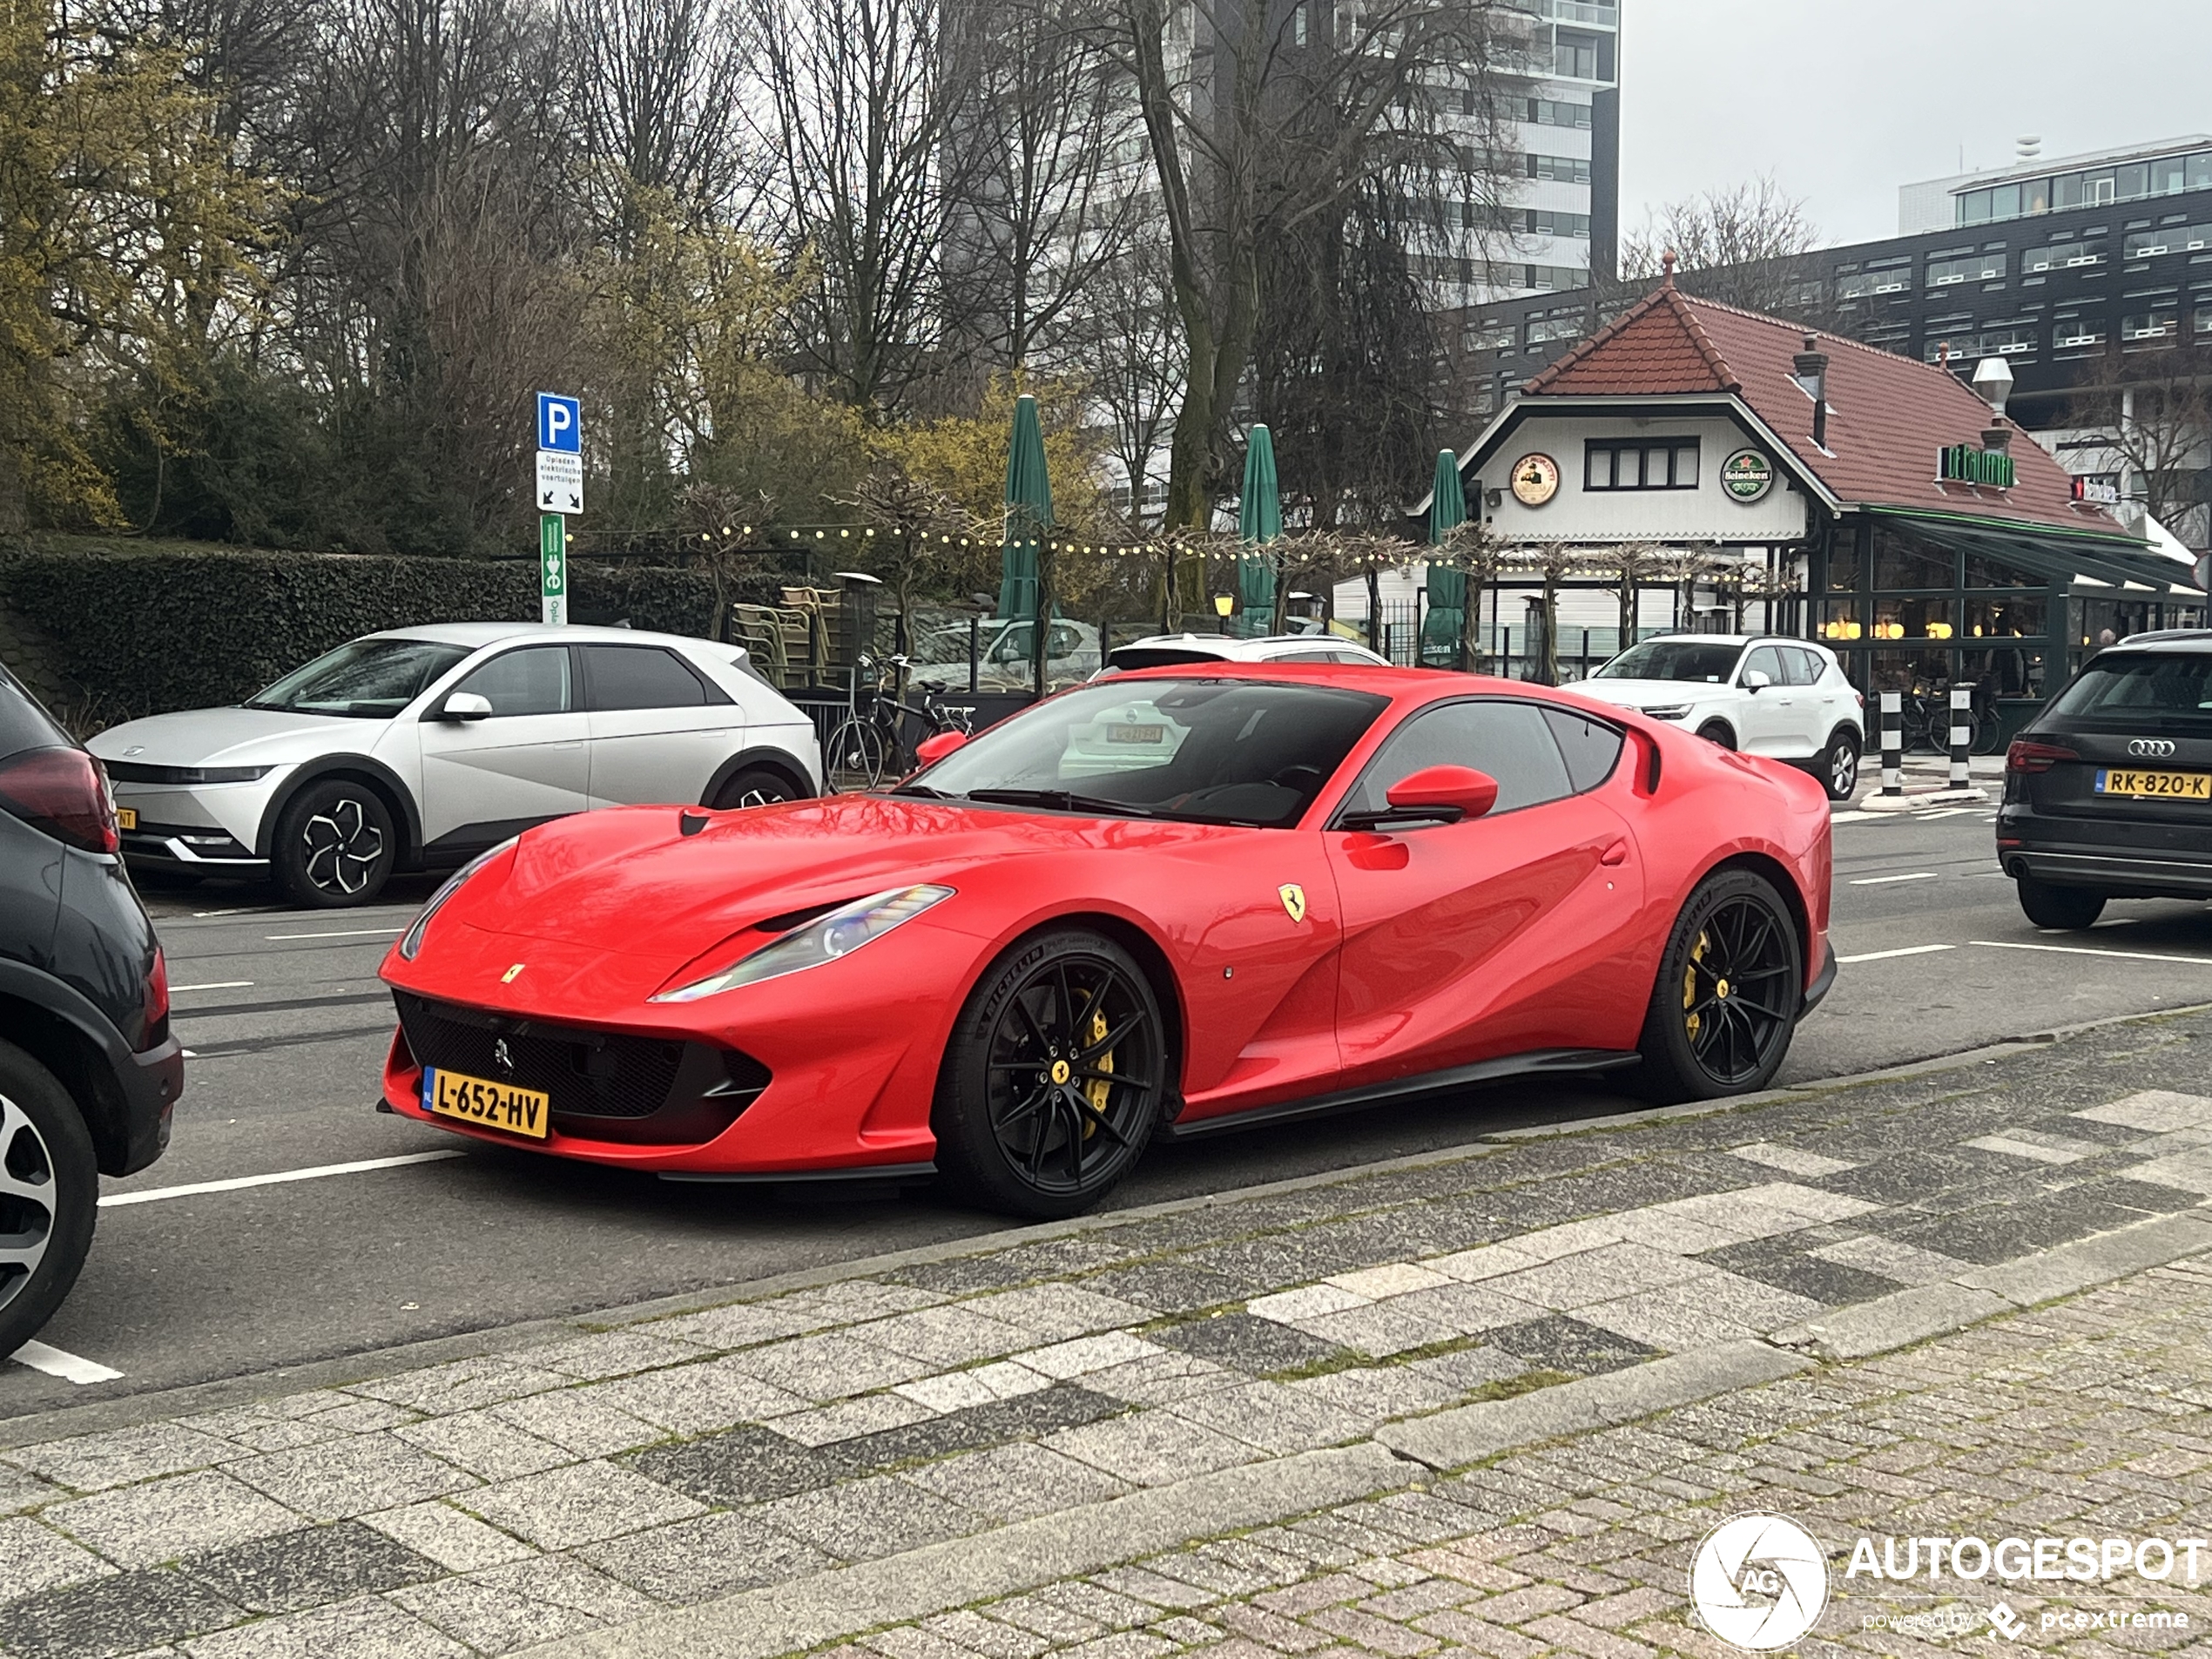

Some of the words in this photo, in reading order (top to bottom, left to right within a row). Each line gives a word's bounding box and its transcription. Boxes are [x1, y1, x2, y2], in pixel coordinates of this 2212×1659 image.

[548, 402, 571, 444] P
[546, 455, 576, 465] Opladen
[1724, 470, 1769, 481] Heineken
[2111, 772, 2204, 795] RK-820-K
[986, 948, 1041, 1017] MICHELIN
[438, 1075, 541, 1130] L-652-HV
